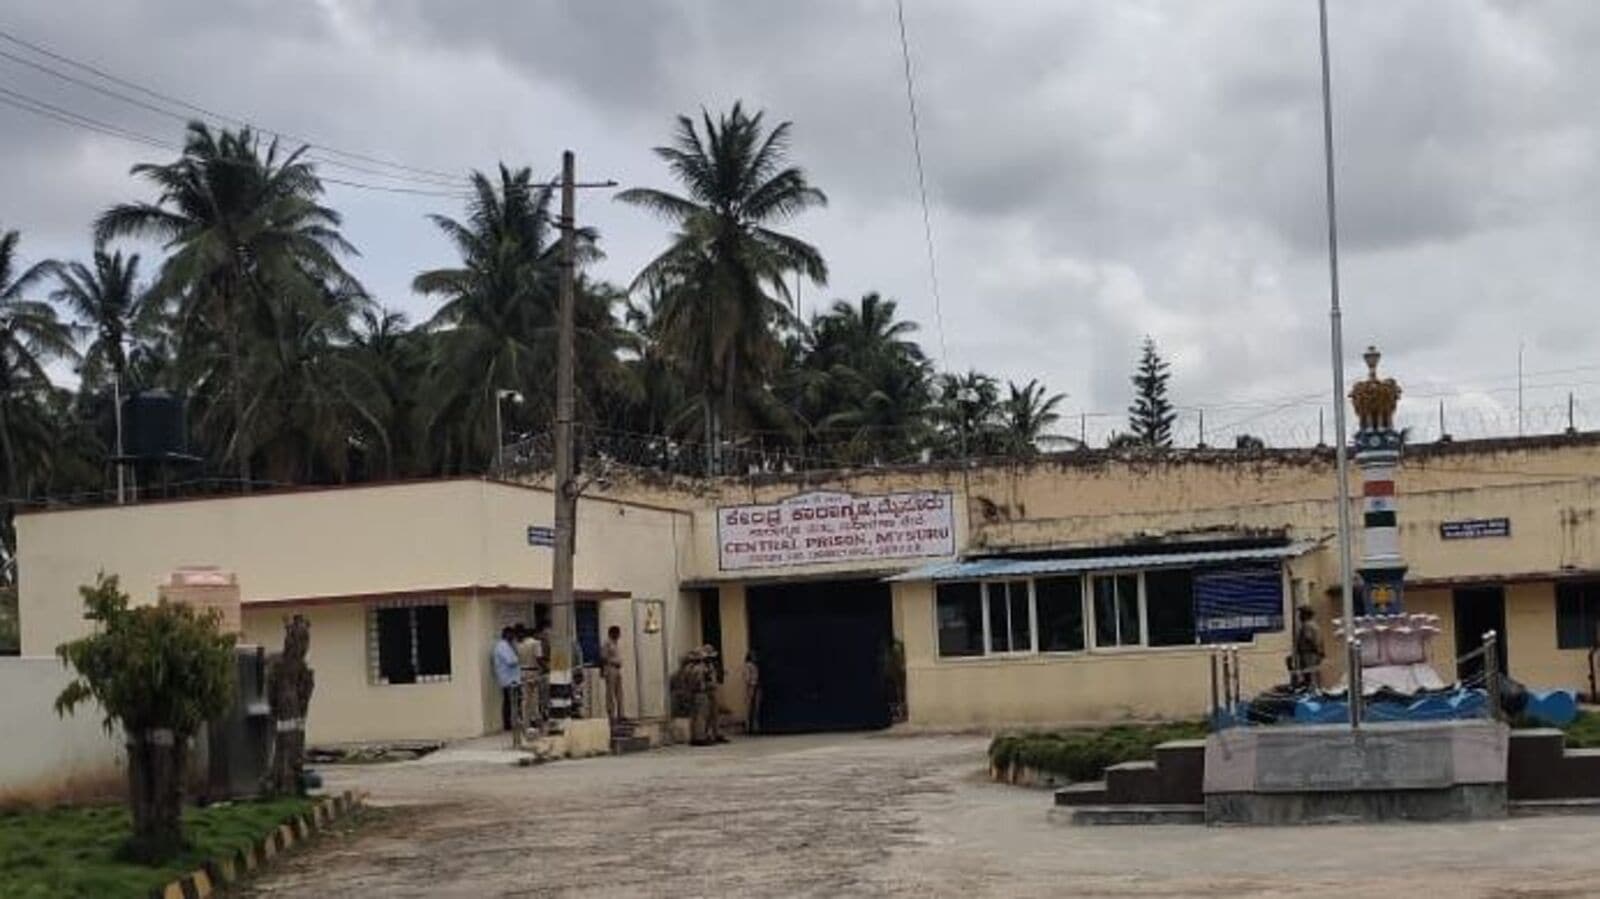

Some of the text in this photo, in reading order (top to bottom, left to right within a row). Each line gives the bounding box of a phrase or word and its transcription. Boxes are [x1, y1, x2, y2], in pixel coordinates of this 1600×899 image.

[726, 508, 780, 527] ಕೇಂದ್ರ
[725, 540, 797, 554] CENTRAL
[876, 527, 949, 544] MYSURU
